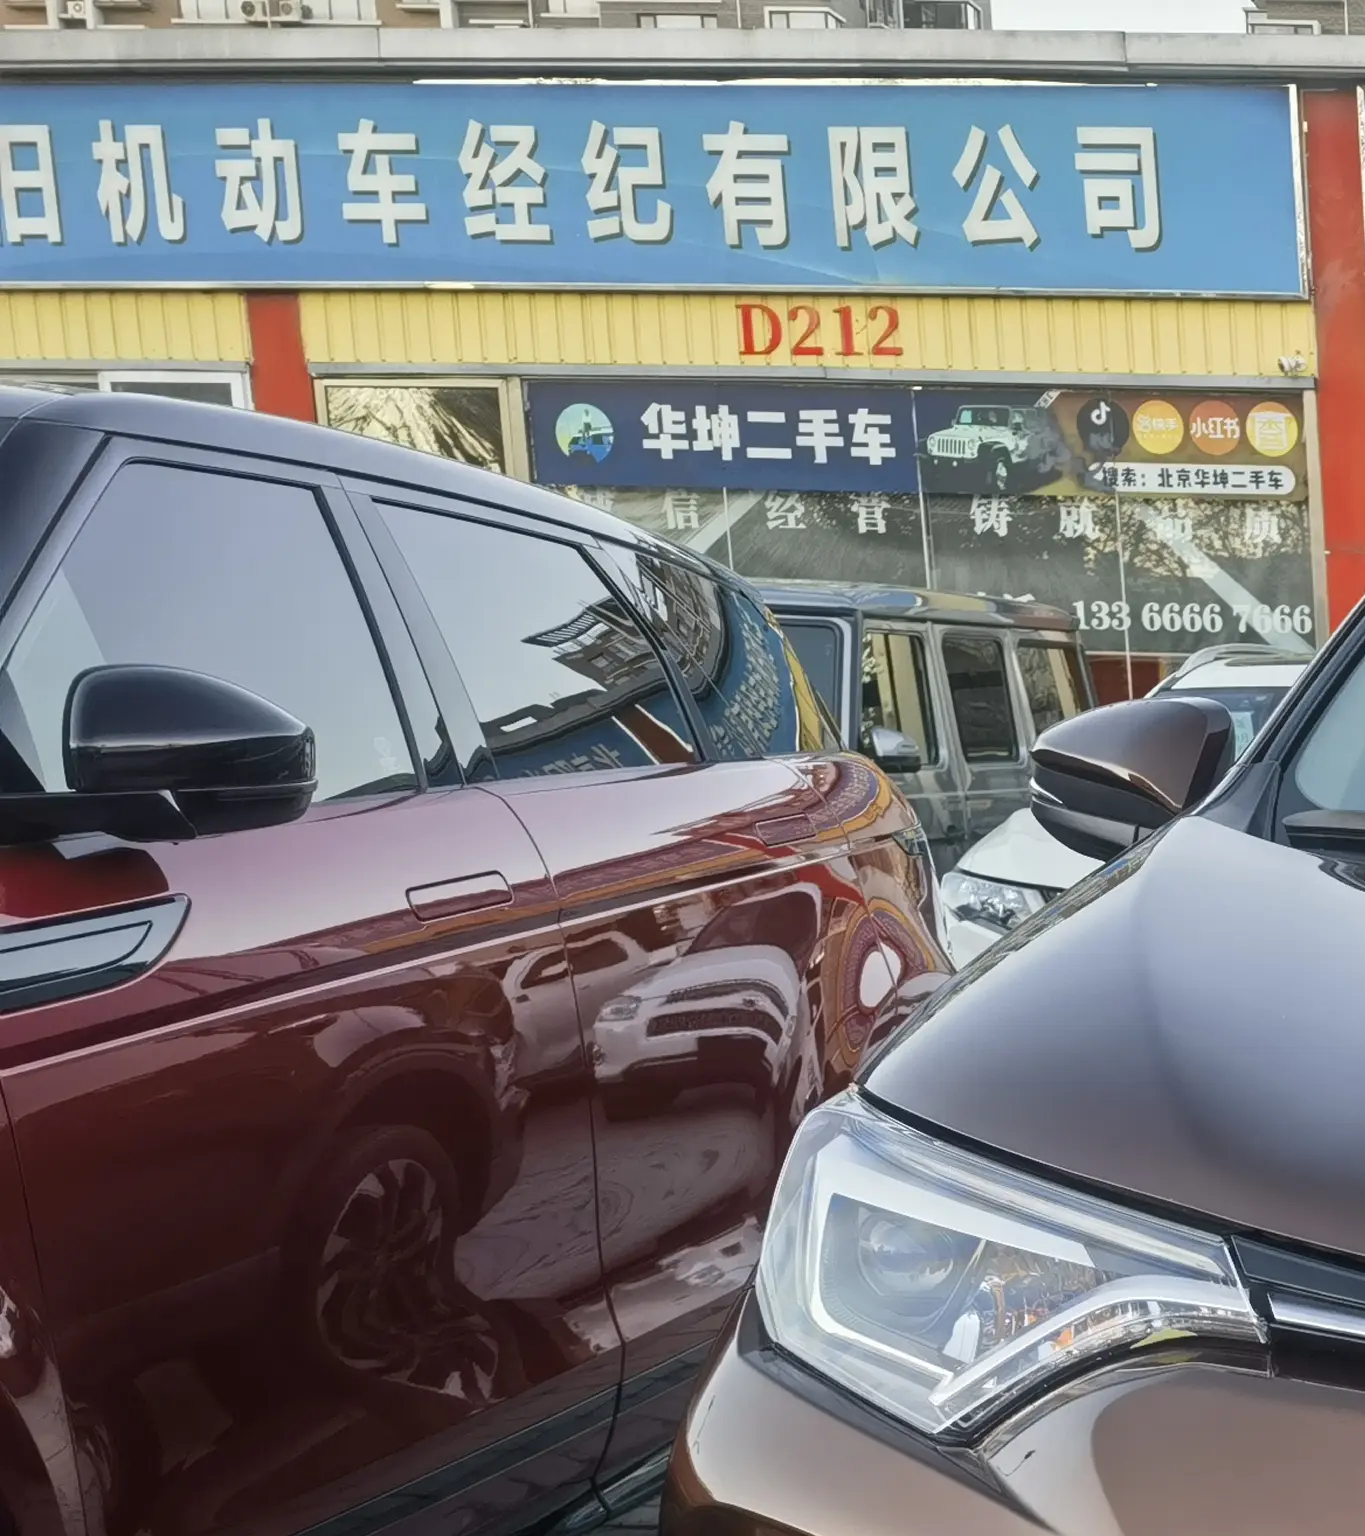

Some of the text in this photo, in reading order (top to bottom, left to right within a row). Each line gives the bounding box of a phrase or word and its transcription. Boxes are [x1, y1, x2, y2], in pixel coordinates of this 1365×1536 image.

[737, 304, 904, 357] D212
[640, 402, 897, 466] 华坤二手车
[1190, 416, 1241, 439] 小红书
[1073, 601, 1312, 634] 133 6666 7666
